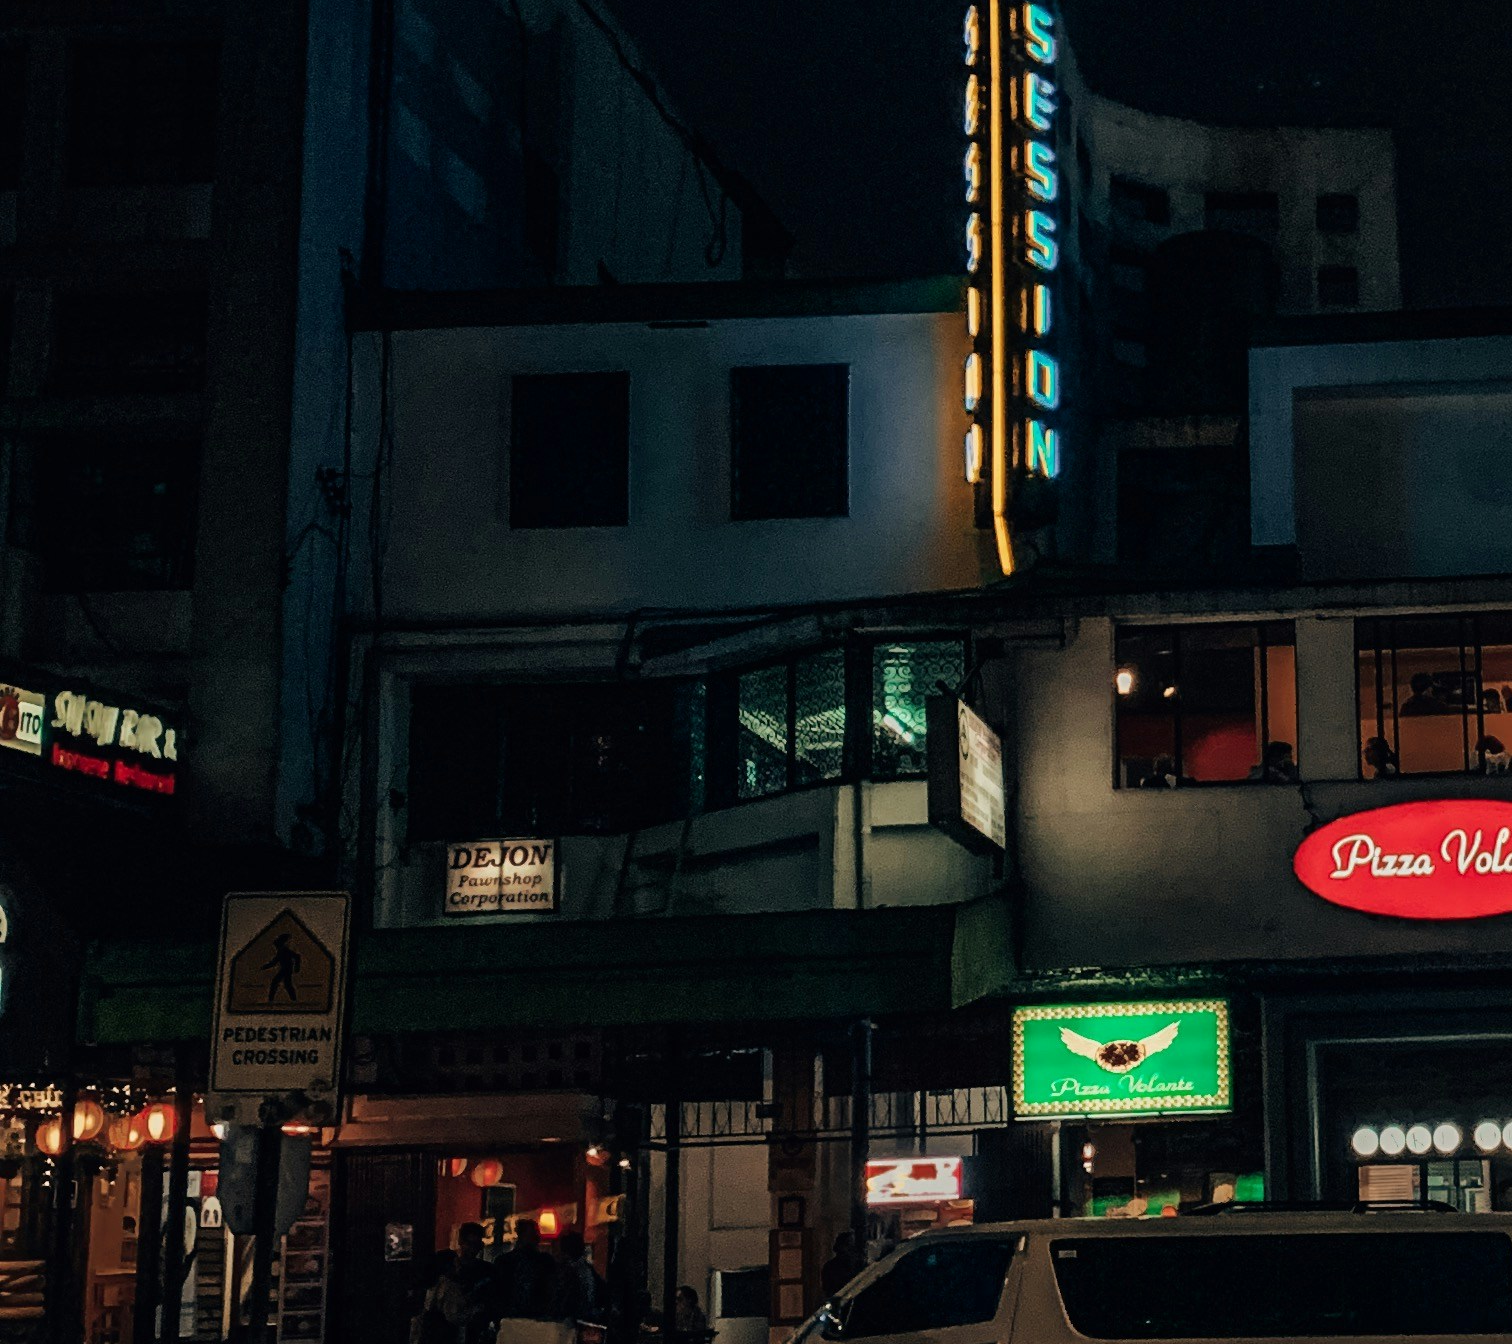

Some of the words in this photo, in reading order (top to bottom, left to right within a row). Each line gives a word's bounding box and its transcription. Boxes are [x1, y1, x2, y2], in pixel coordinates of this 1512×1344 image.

[1024, 2, 1059, 481] SESSION
[450, 845, 552, 869] DEJON
[1329, 833, 1435, 880] Pizza
[458, 873, 542, 888] Pawnshop
[450, 891, 548, 907] Corporation
[223, 1026, 332, 1043] PEDESTRIAN
[232, 1049, 318, 1065] CROSSING
[1051, 1077, 1110, 1097] Pizza
[1119, 1072, 1195, 1093] Volante
